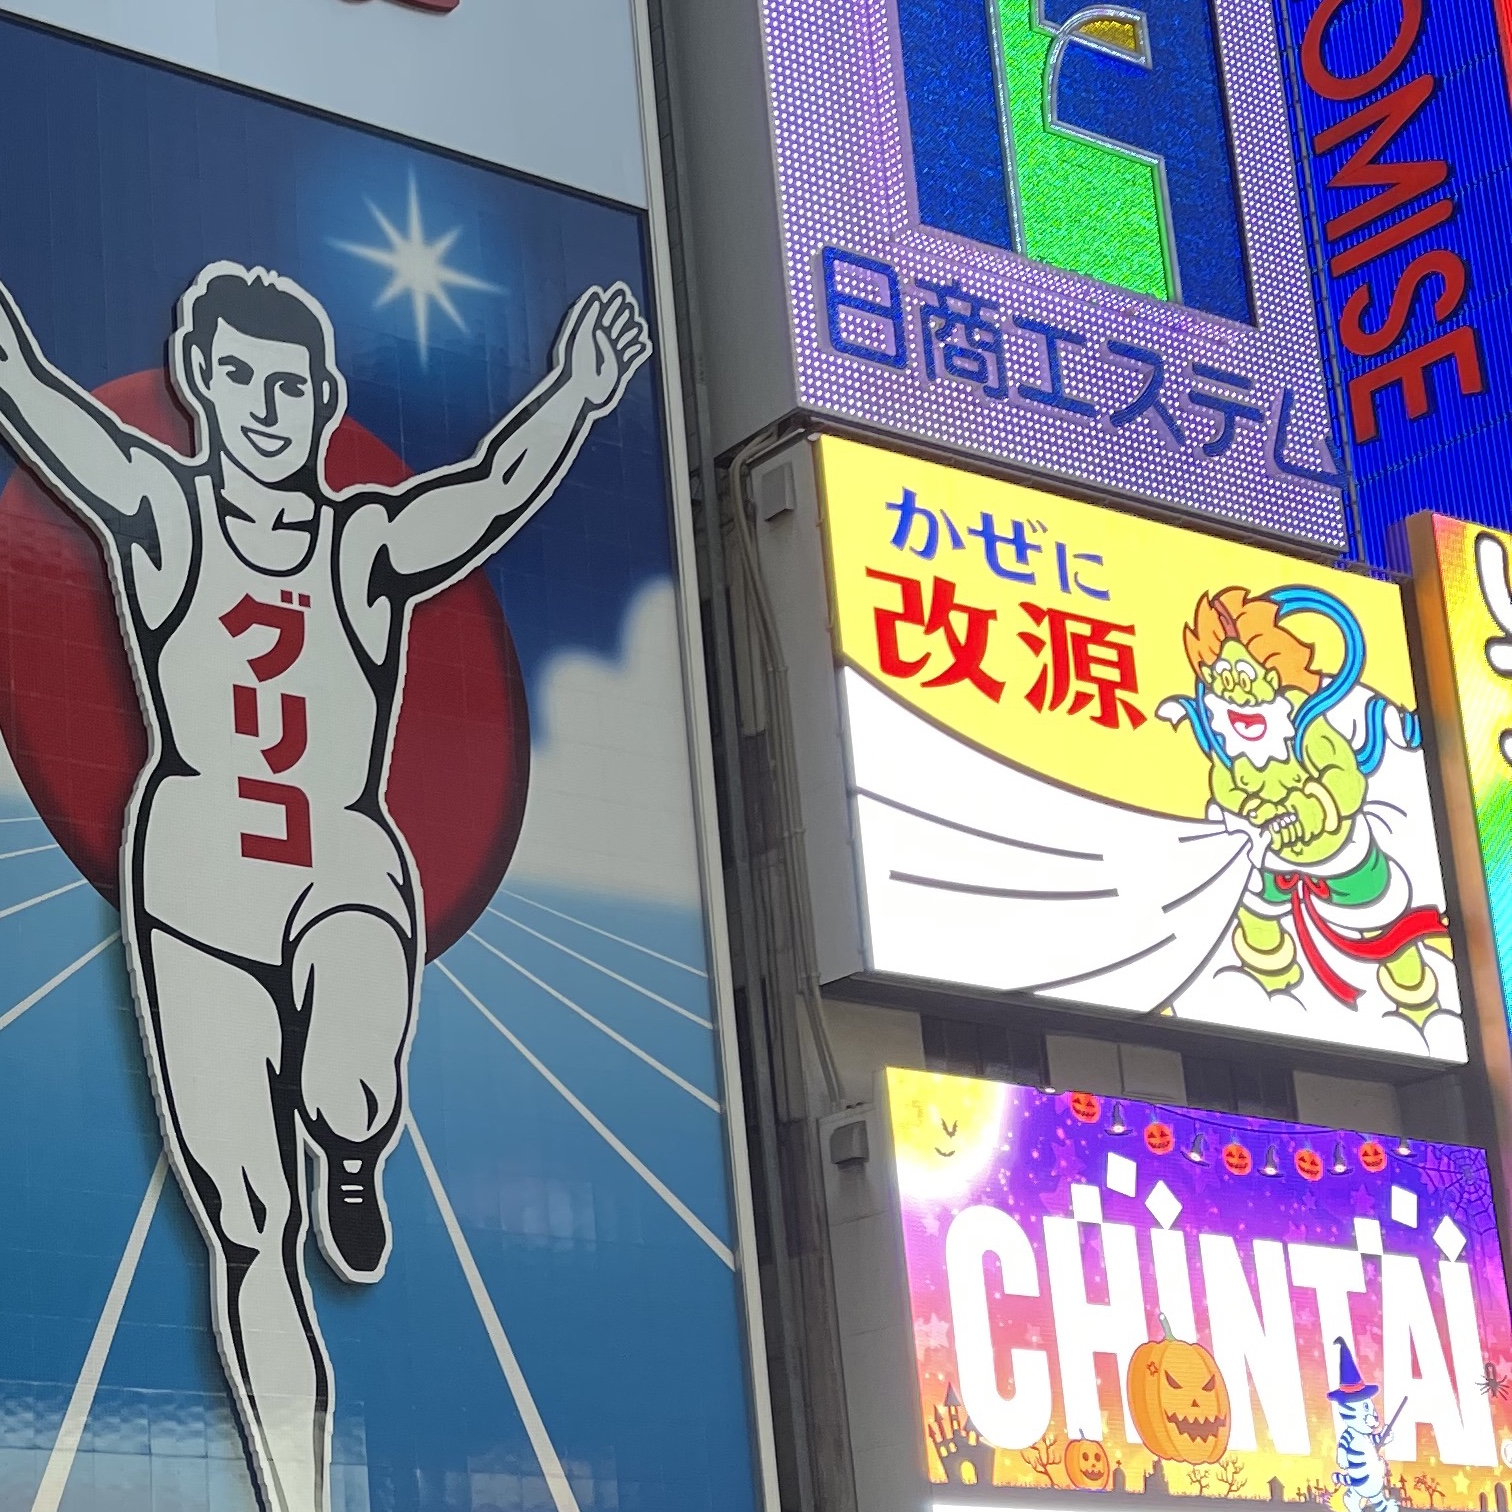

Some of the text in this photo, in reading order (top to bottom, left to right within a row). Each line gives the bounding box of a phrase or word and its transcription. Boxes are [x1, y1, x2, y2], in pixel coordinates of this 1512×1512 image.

[885, 486, 1110, 601] かぜに
[218, 589, 313, 868] グリコ
[865, 566, 1148, 731] 改源
